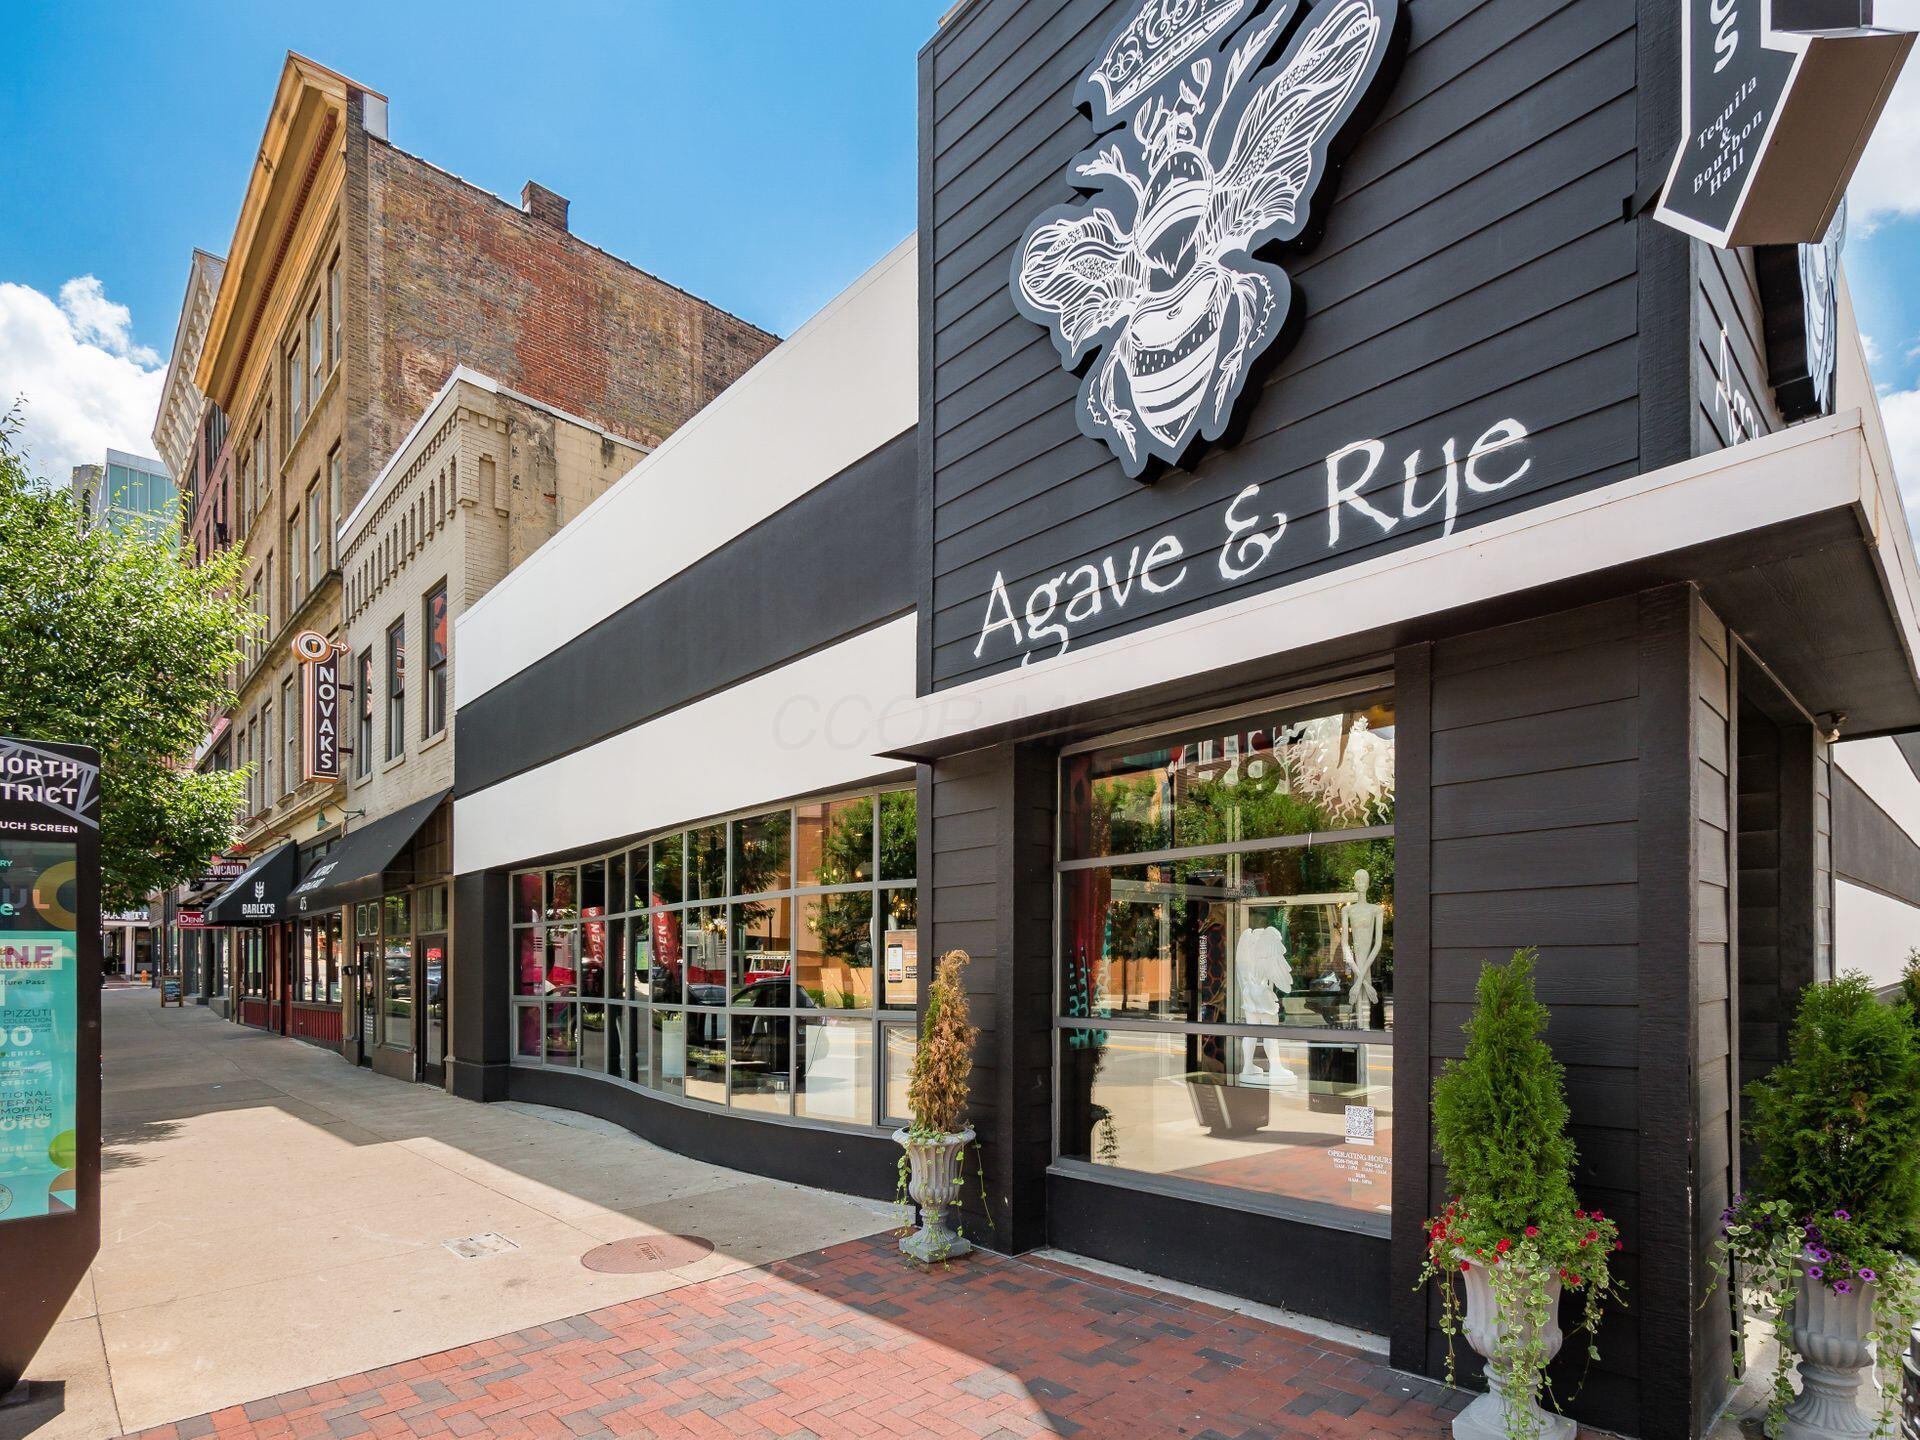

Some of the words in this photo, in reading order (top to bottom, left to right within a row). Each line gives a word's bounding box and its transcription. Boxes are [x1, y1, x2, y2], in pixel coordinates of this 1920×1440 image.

[1697, 77, 1757, 150] Tequila
[1693, 110, 1763, 194] Bourbon
[1719, 127, 1732, 149] &
[1710, 147, 1745, 197] Hall
[973, 533, 1187, 667] Agave
[1218, 484, 1287, 580] &
[1325, 417, 1532, 547] Rye
[318, 666, 336, 769] NOVAKS
[0, 783, 78, 804] TRICT
[30, 823, 78, 833] SCREEN
[242, 903, 275, 914] BARLEY'S
[590, 923, 603, 963] OPEN
[658, 925, 669, 964] OPEN
[3, 1009, 52, 1017] PIZZUTI
[1328, 1149, 1367, 1161] OPERATING
